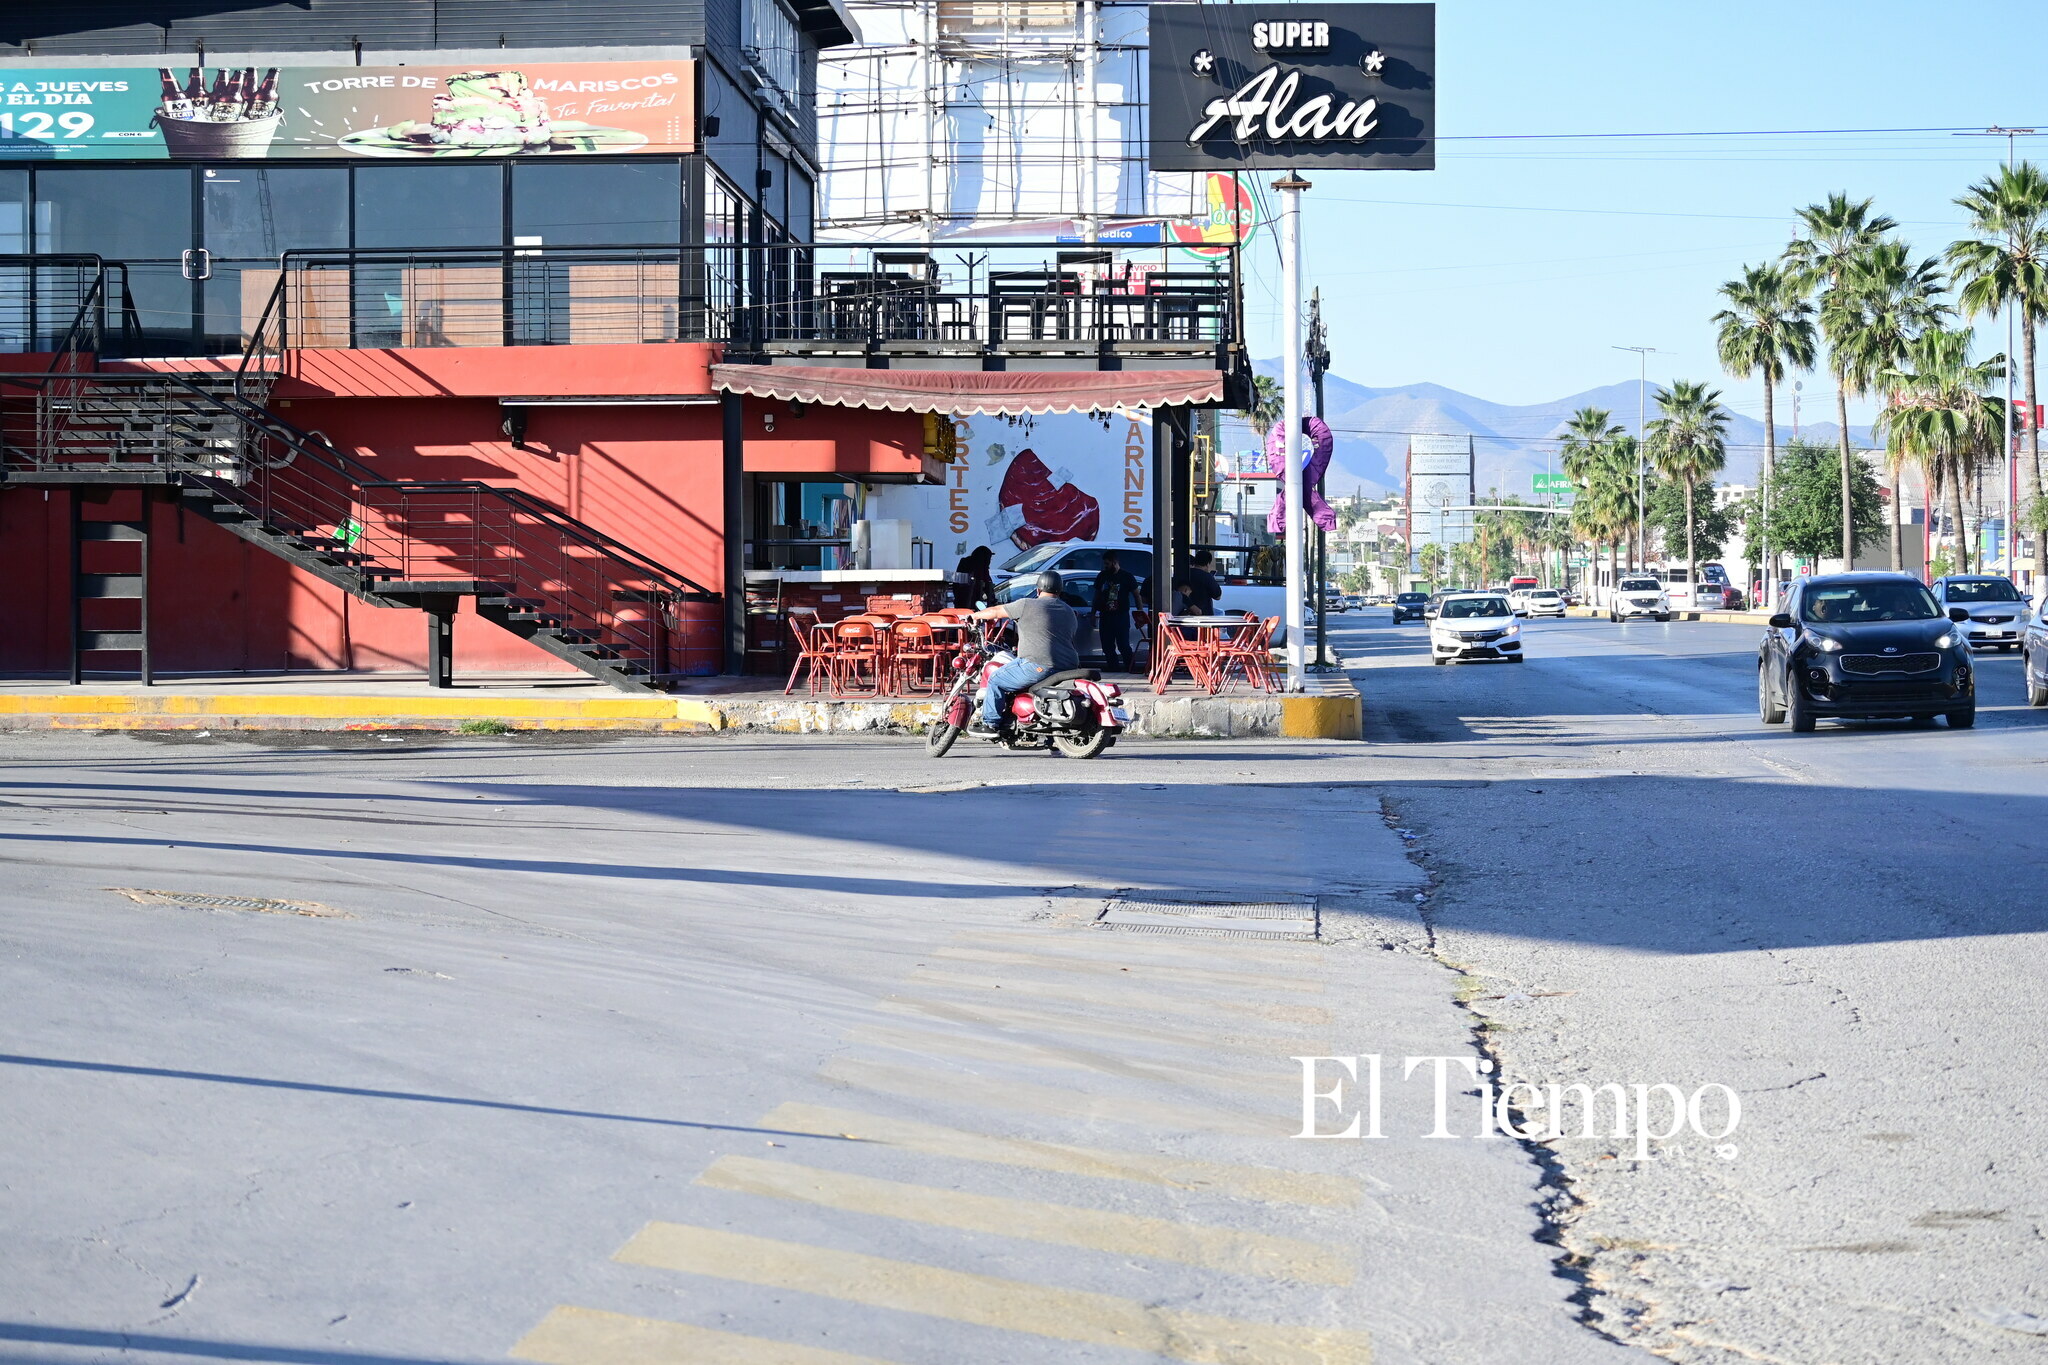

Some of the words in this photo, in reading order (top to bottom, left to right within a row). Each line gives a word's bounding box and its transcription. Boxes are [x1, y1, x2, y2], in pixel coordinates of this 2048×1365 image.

[1252, 22, 1330, 48] SUPER
[11, 82, 30, 92] A
[35, 81, 129, 92] JUEVES
[303, 76, 396, 94] TORRE
[401, 75, 439, 89] DE
[533, 72, 679, 93] MARISCOS
[6, 93, 40, 105] EL
[43, 93, 93, 105] DIA
[1189, 66, 1378, 142] Alan
[553, 102, 578, 118] Tu
[0, 111, 95, 139] 129
[1119, 264, 1157, 272] SVICIO
